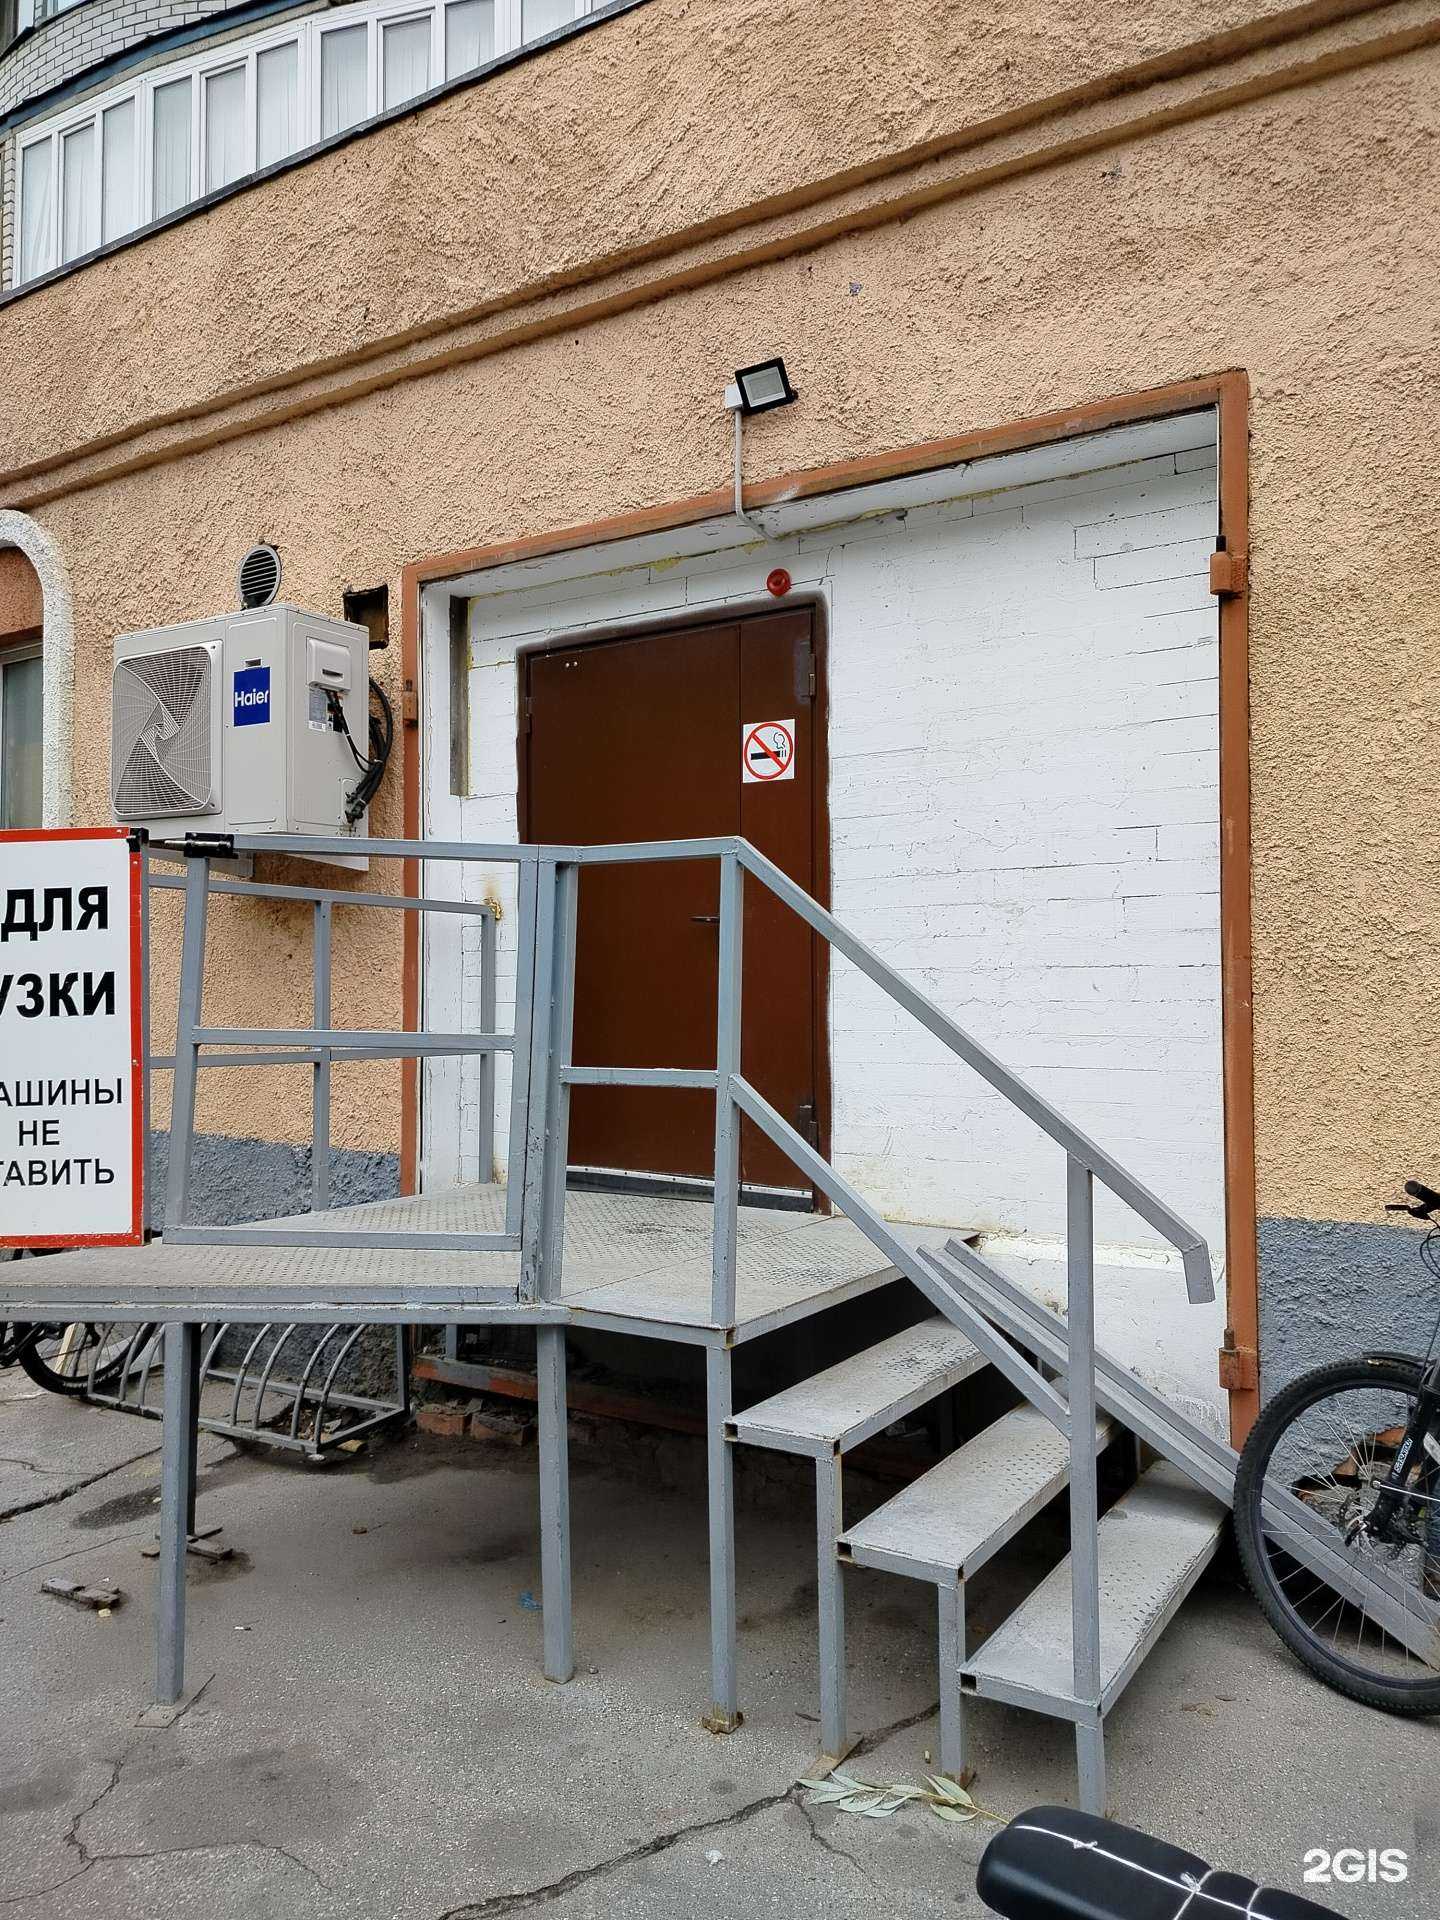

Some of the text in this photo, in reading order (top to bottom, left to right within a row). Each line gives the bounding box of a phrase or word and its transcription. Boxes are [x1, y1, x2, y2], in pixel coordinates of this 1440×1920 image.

[234, 688, 269, 708] Haier
[1, 886, 108, 942] ДЛЯ
[19, 1119, 60, 1146] НЕ
[0, 1158, 115, 1186] АВИТЬ
